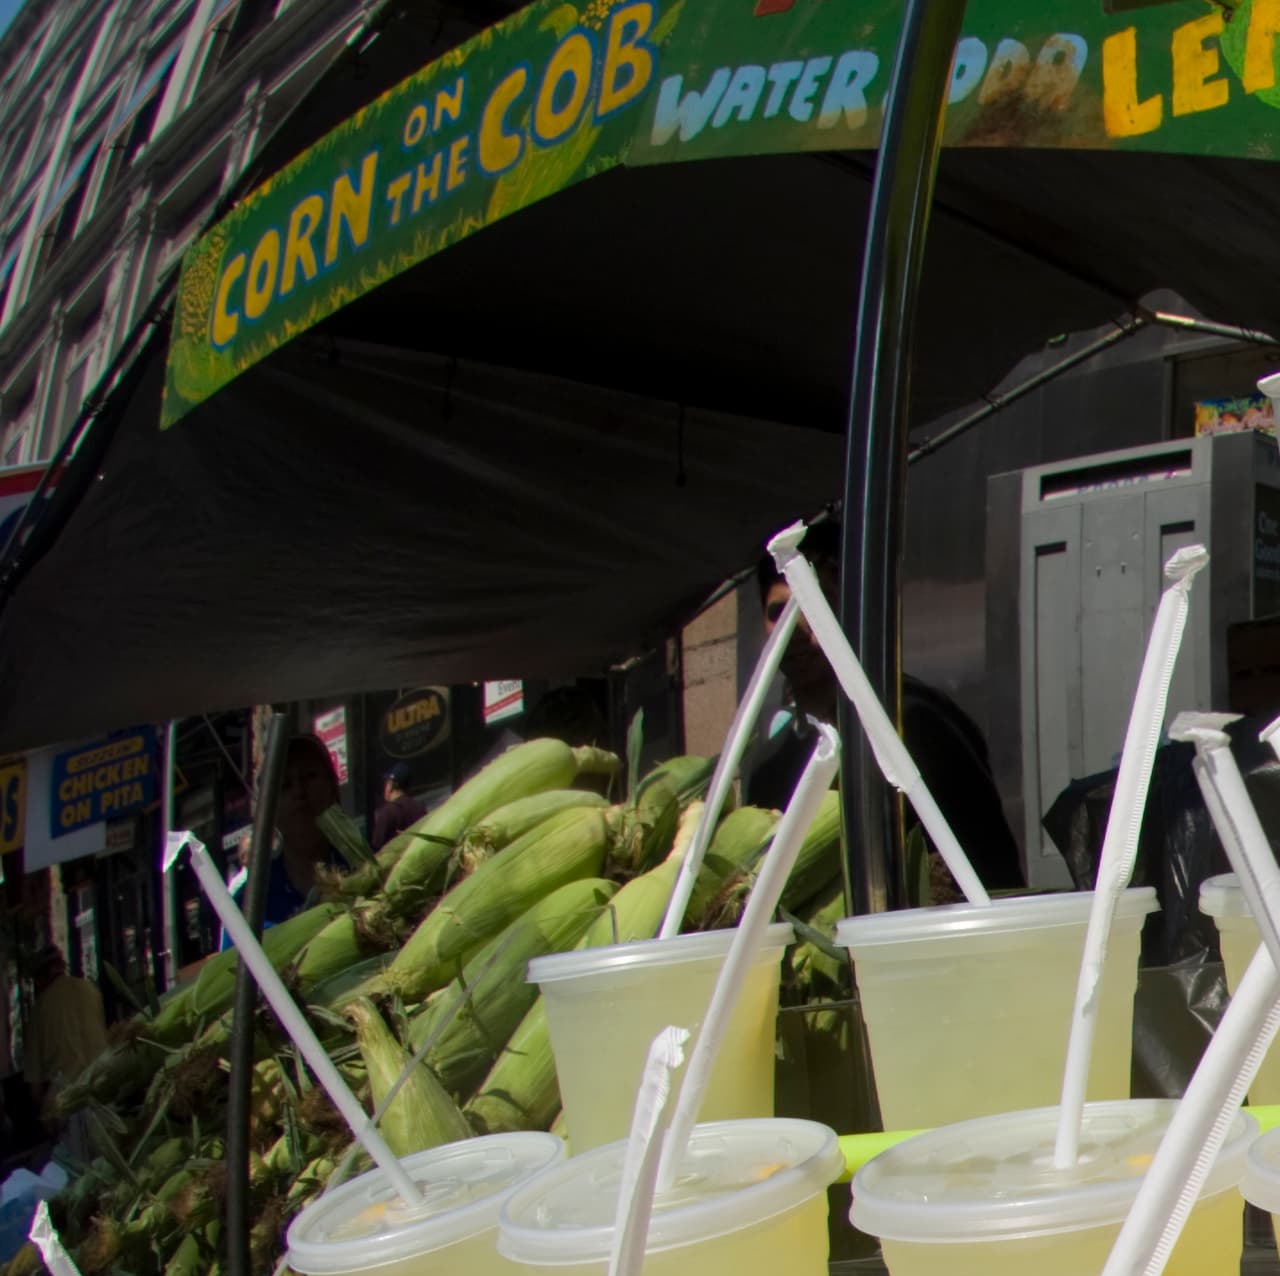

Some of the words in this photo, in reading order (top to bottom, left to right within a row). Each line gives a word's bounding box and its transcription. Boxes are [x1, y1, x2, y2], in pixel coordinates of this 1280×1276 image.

[403, 74, 465, 147] ON
[477, 2, 655, 173] COB
[651, 50, 880, 146] WATER
[387, 135, 470, 225] THE
[212, 151, 379, 347] CORN
[386, 695, 441, 735] ULTRA
[59, 753, 149, 800] CHICKEN
[61, 798, 92, 827] ON
[100, 782, 143, 814] PITA
